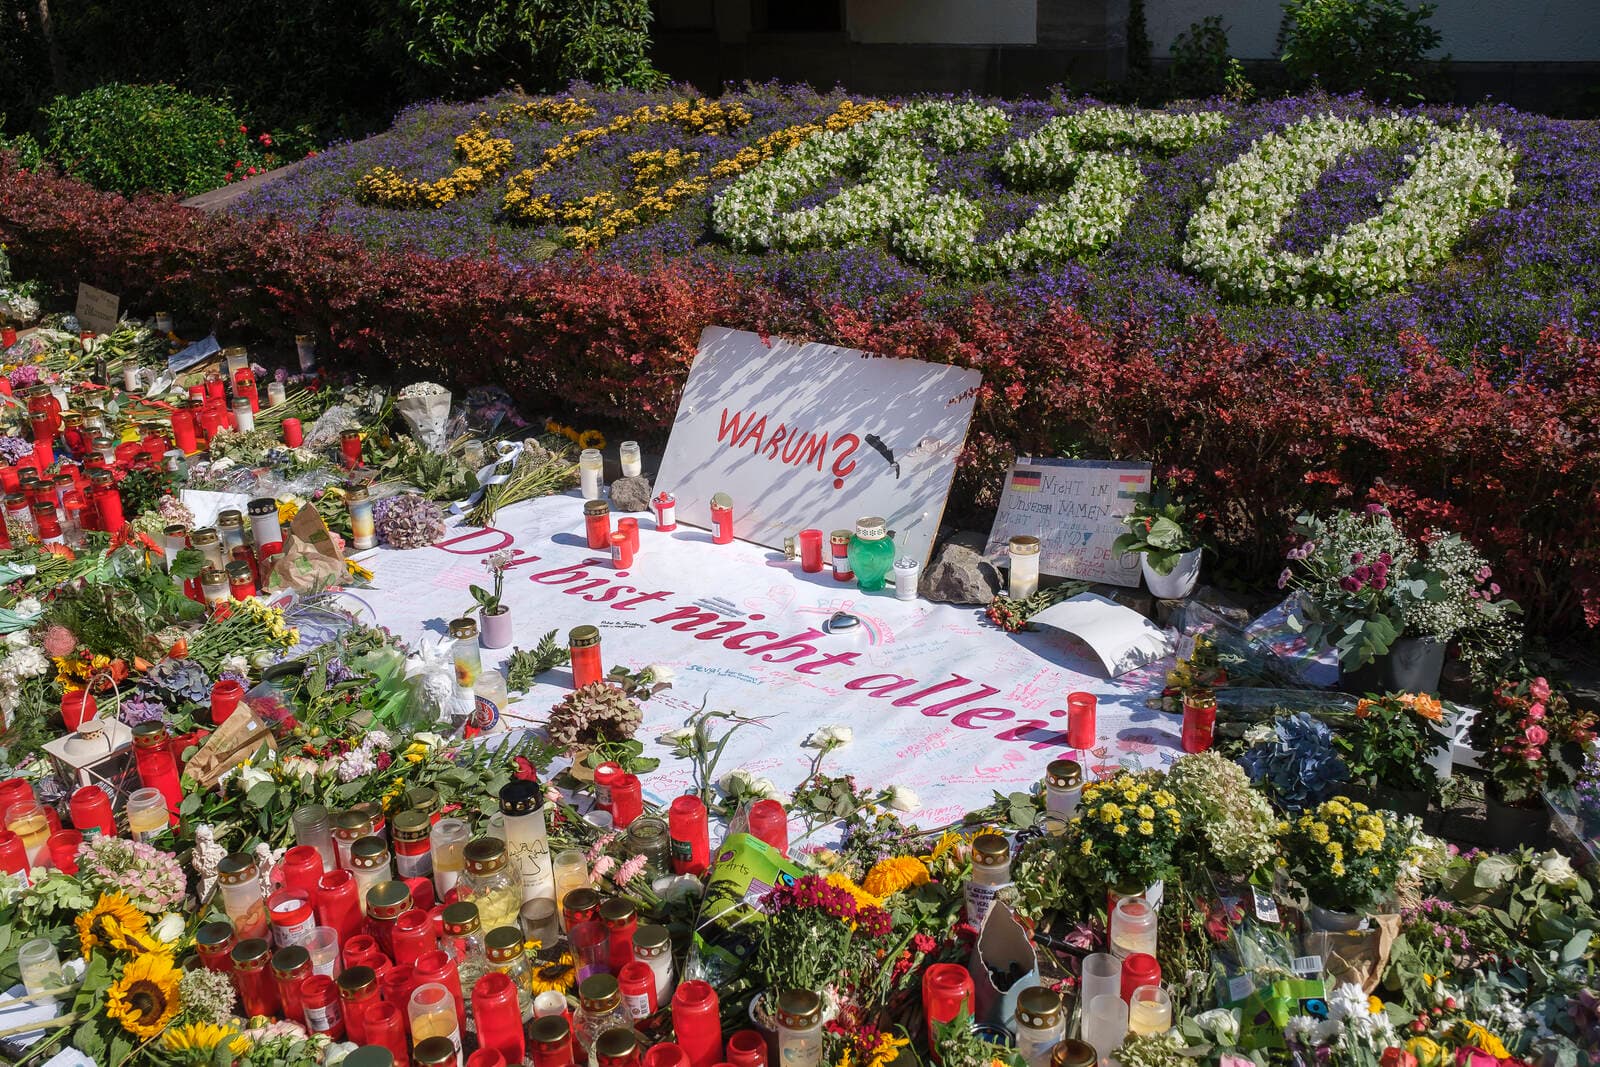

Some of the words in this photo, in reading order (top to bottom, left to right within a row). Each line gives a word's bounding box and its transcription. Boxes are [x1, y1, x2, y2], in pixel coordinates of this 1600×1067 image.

[711, 99, 1517, 309] 650
[717, 407, 860, 490] WARUM?
[1057, 500, 1111, 521] NAMEN
[529, 557, 675, 611] bist
[650, 606, 863, 675] nicht
